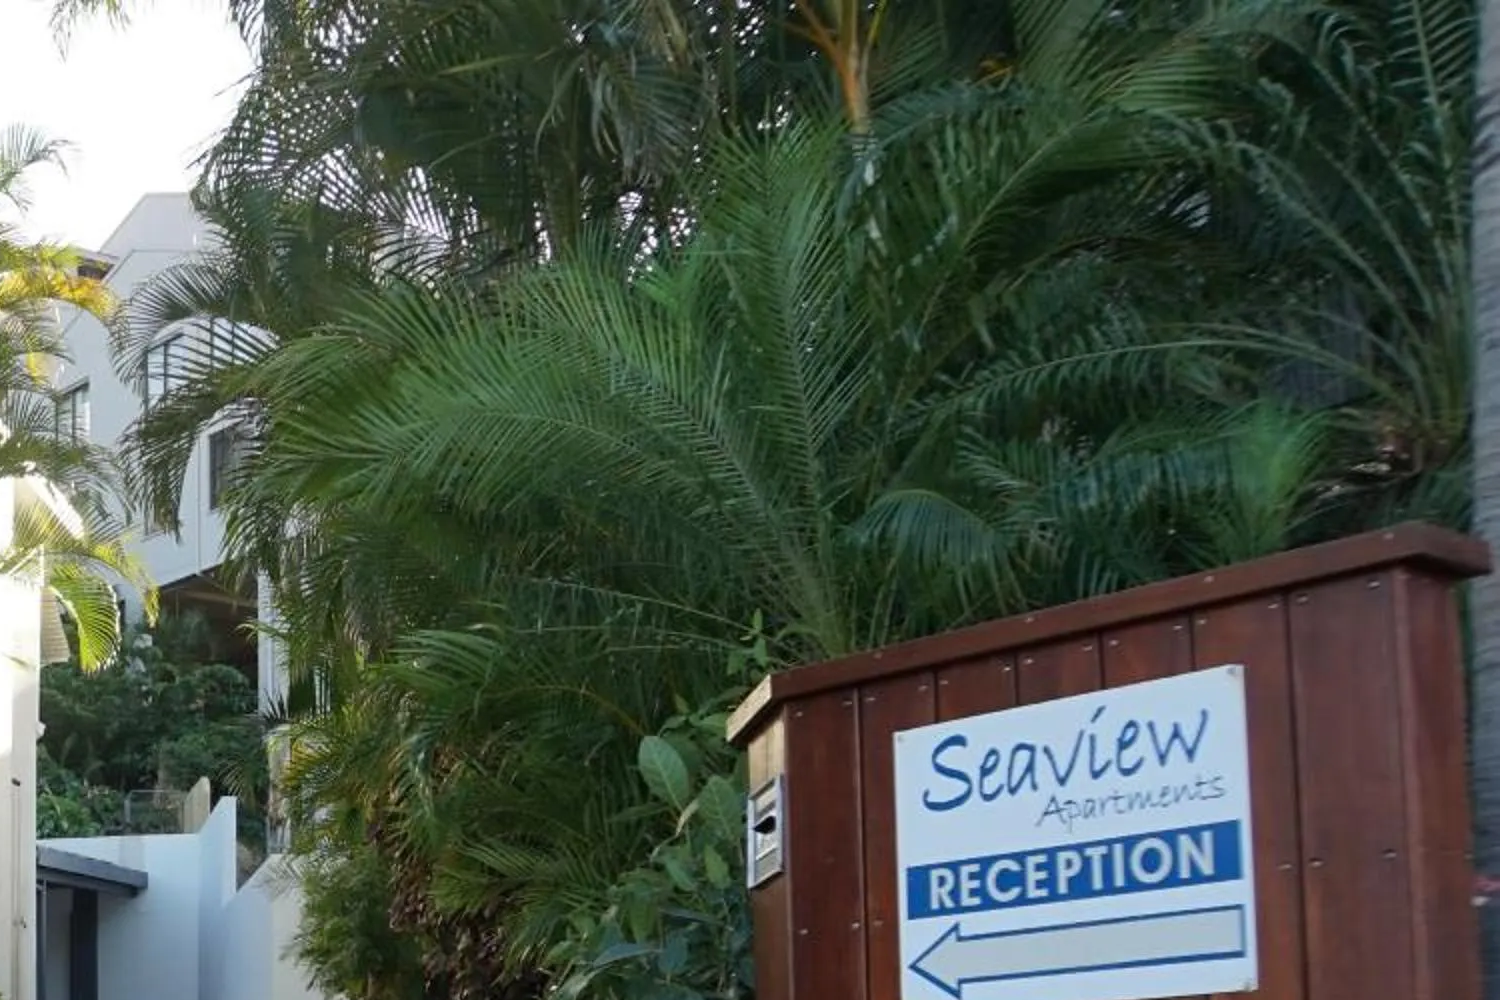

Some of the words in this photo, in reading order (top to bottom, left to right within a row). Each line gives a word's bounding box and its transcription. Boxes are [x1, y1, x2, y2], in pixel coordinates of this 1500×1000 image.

[923, 705, 1208, 811] Seaview
[1034, 774, 1226, 832] Apartments
[930, 831, 1215, 910] RECEPTION
